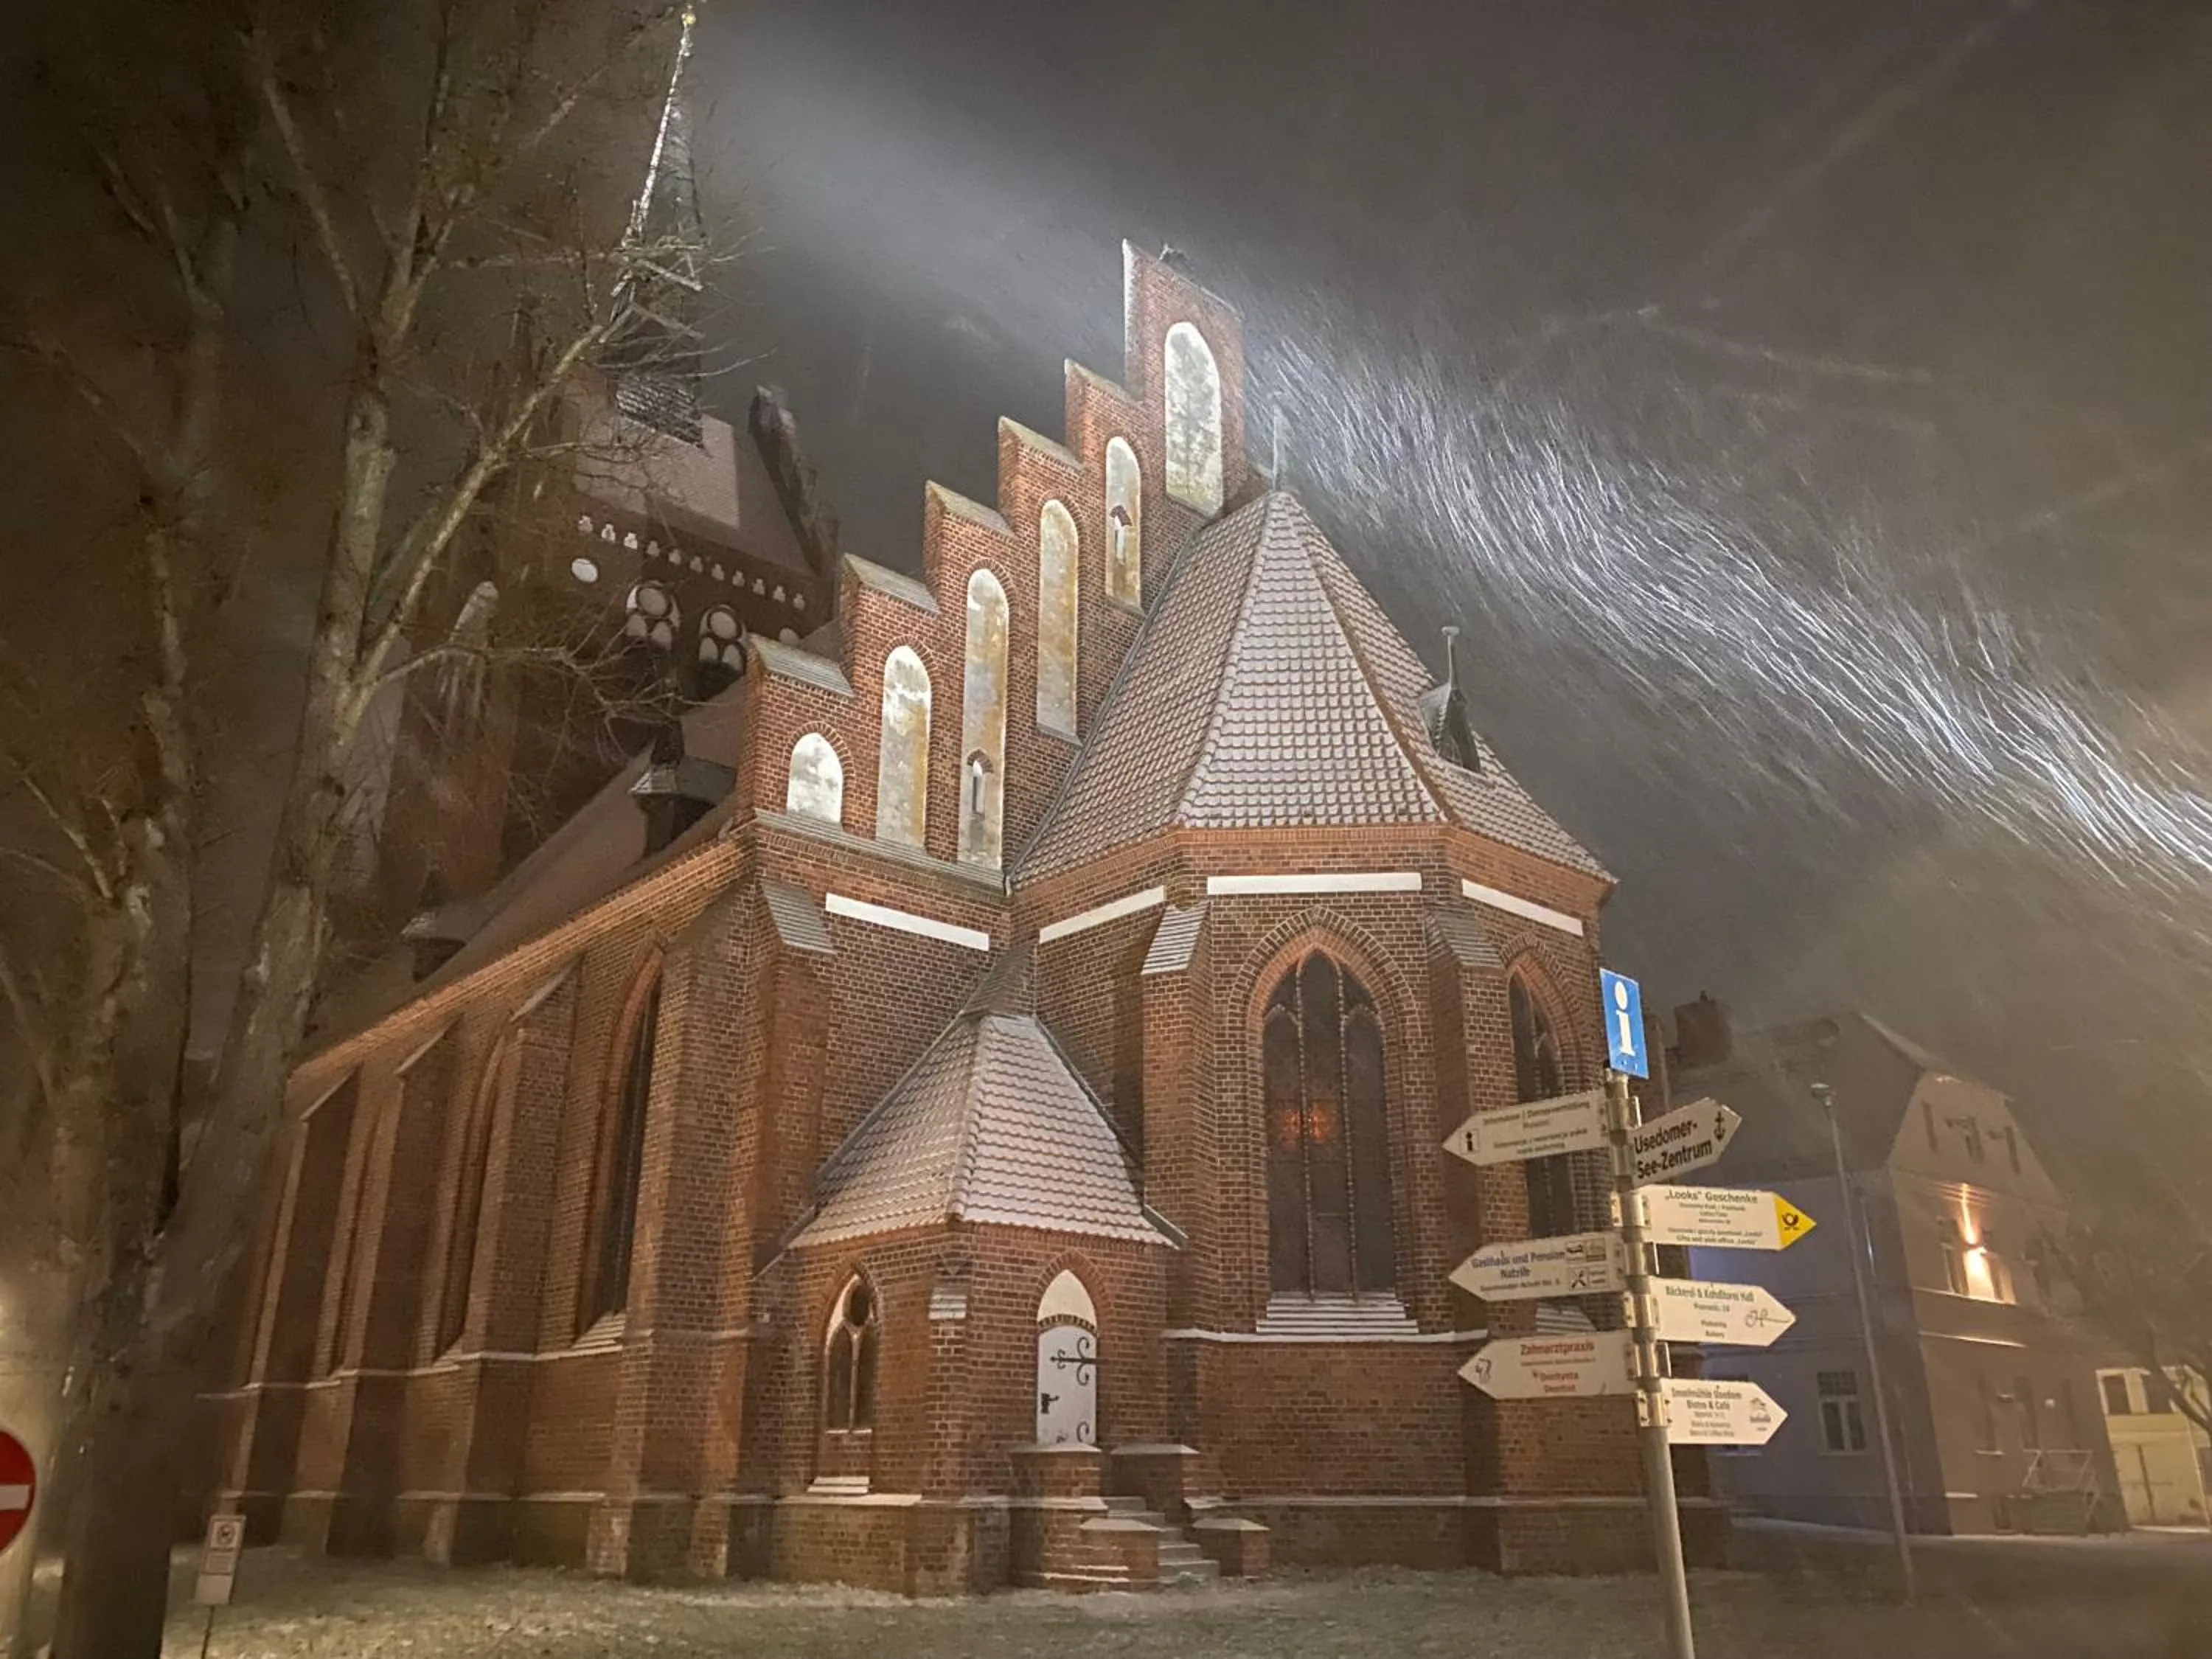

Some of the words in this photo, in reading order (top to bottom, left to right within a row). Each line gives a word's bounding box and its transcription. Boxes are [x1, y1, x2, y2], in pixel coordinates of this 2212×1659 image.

[1633, 1120, 1698, 1155] Usedomer-
[1636, 1139, 1713, 1179] See-Zentrum
[1705, 1191, 1759, 1204] Geschenke
[1512, 1253, 1528, 1264] und
[1530, 1251, 1565, 1262] Pension
[1520, 1340, 1596, 1356] Zahnarztpraxis
